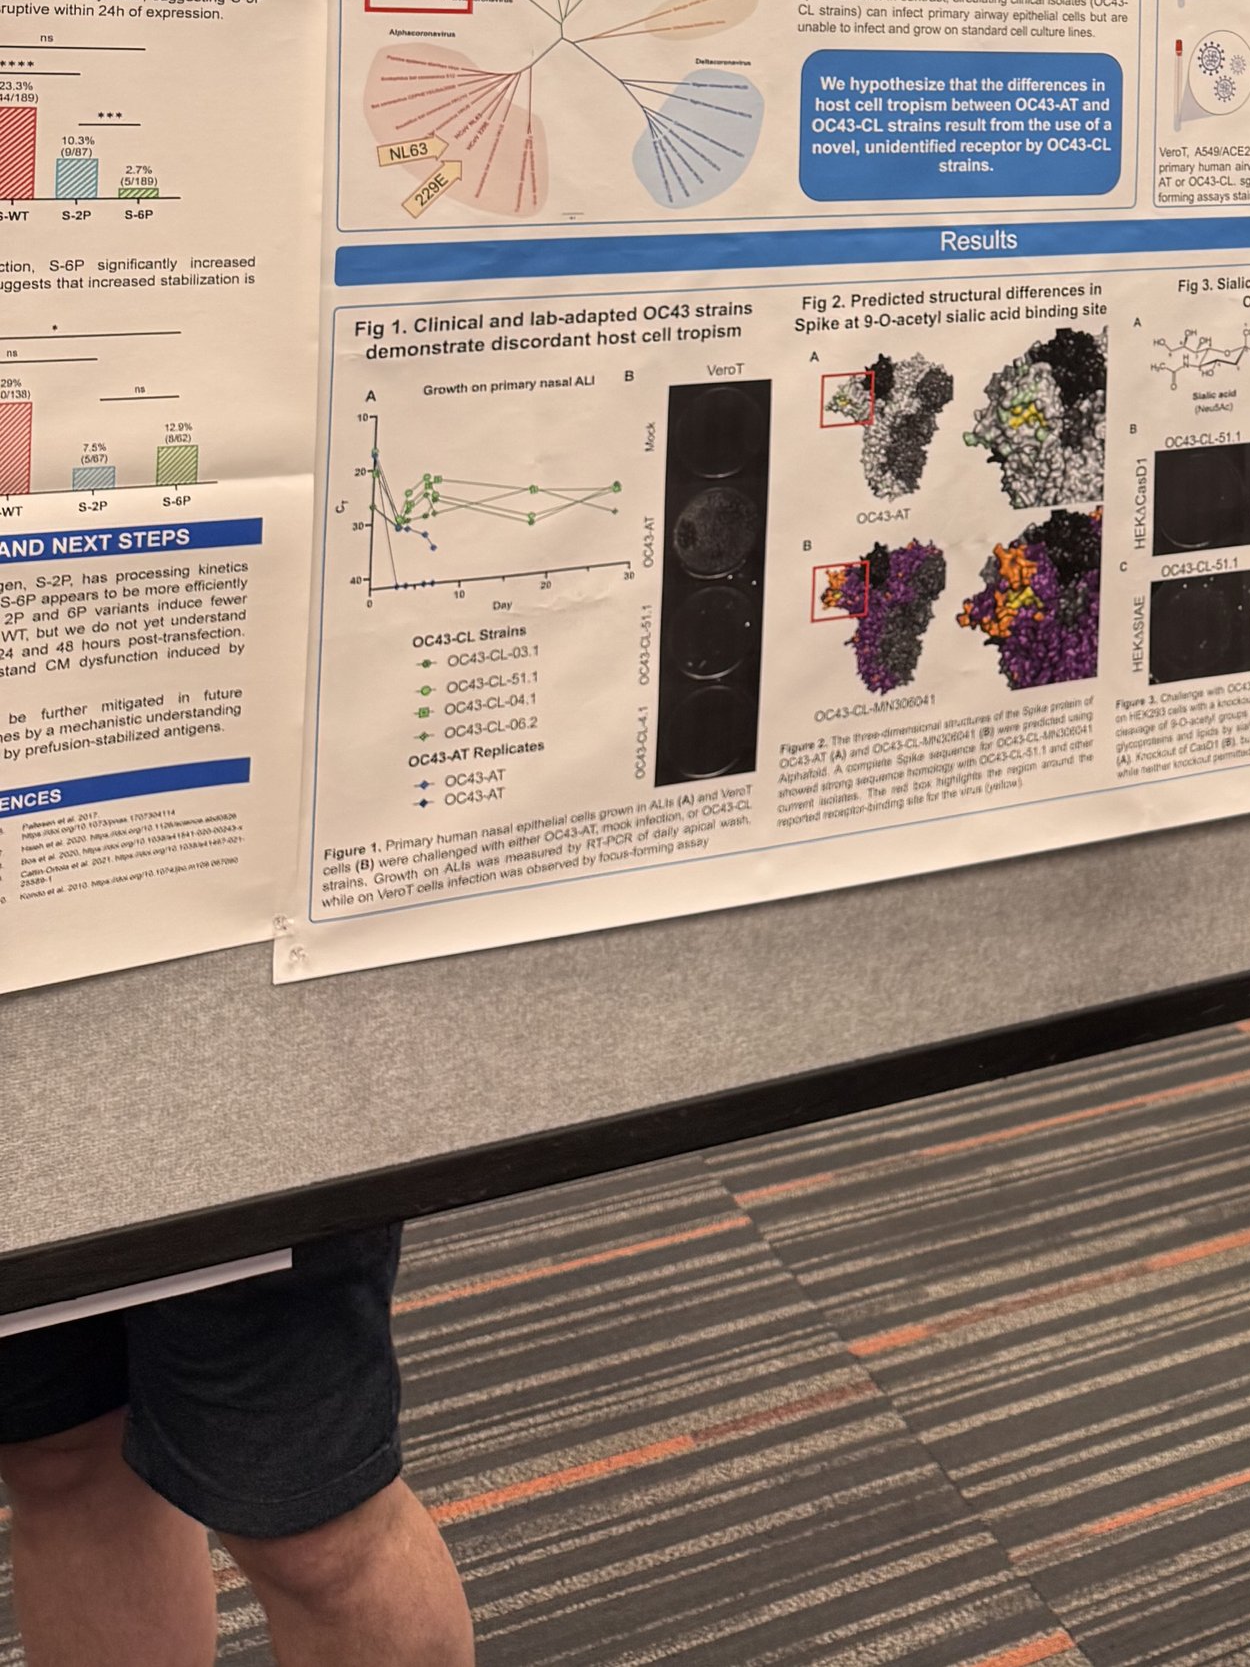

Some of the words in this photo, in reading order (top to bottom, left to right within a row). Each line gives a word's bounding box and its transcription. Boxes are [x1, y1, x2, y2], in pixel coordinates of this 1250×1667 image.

[820, 76, 845, 90] We
[850, 76, 945, 94] hypothesize
[949, 77, 977, 91] that
[980, 77, 1004, 91] the
[1007, 77, 1088, 91] differences
[1092, 78, 1105, 91] in
[61, 136, 95, 146] 10.3%
[389, 141, 429, 160] NL63
[60, 147, 93, 159] (9/87)
[125, 165, 153, 175] 2.7%
[120, 176, 158, 187] (5/189)
[414, 172, 449, 207] 229E
[62, 211, 92, 221] S-2P
[124, 209, 154, 220] S-6P
[941, 229, 1017, 251] Results
[1178, 278, 1198, 295] Fig
[1202, 278, 1213, 291] 3.
[802, 295, 827, 313] Fig
[831, 294, 845, 308] 2.
[850, 290, 924, 307] Predicted
[929, 286, 1001, 304] structural
[1005, 285, 1085, 299] differences
[1089, 282, 1102, 295] in
[354, 320, 384, 339] Fig
[391, 318, 407, 334] 1.
[413, 313, 483, 333] Clinical
[489, 311, 524, 328] and
[530, 306, 637, 326] lab-adapted
[642, 304, 690, 320] OC43
[695, 301, 752, 317] strains
[794, 316, 840, 335] Spike
[844, 315, 859, 329] at
[864, 310, 941, 328] 9-O-acetyl
[945, 308, 986, 323] sialic
[989, 306, 1020, 321] acid
[1025, 304, 1078, 320] binding
[1082, 302, 1107, 316] site
[365, 338, 485, 360] demonstrate
[491, 332, 591, 351] discordant
[596, 330, 636, 346] host
[641, 326, 671, 343] cell
[676, 324, 741, 342] tropism
[707, 362, 746, 377] VeroT
[0, 538, 44, 557] AND
[52, 533, 112, 554] NEXT
[118, 528, 190, 549] STEPS
[412, 630, 475, 648] OC43-CL
[479, 625, 526, 641] Strains
[447, 645, 539, 668] OC43-CL-03.1
[446, 671, 538, 694] OC43-CL-51.1
[444, 692, 537, 716] OC43-CL-04.1
[444, 716, 538, 740] OC43-CL-06.2
[444, 769, 507, 788] OC43-AT
[444, 787, 506, 806] OC43-AT
